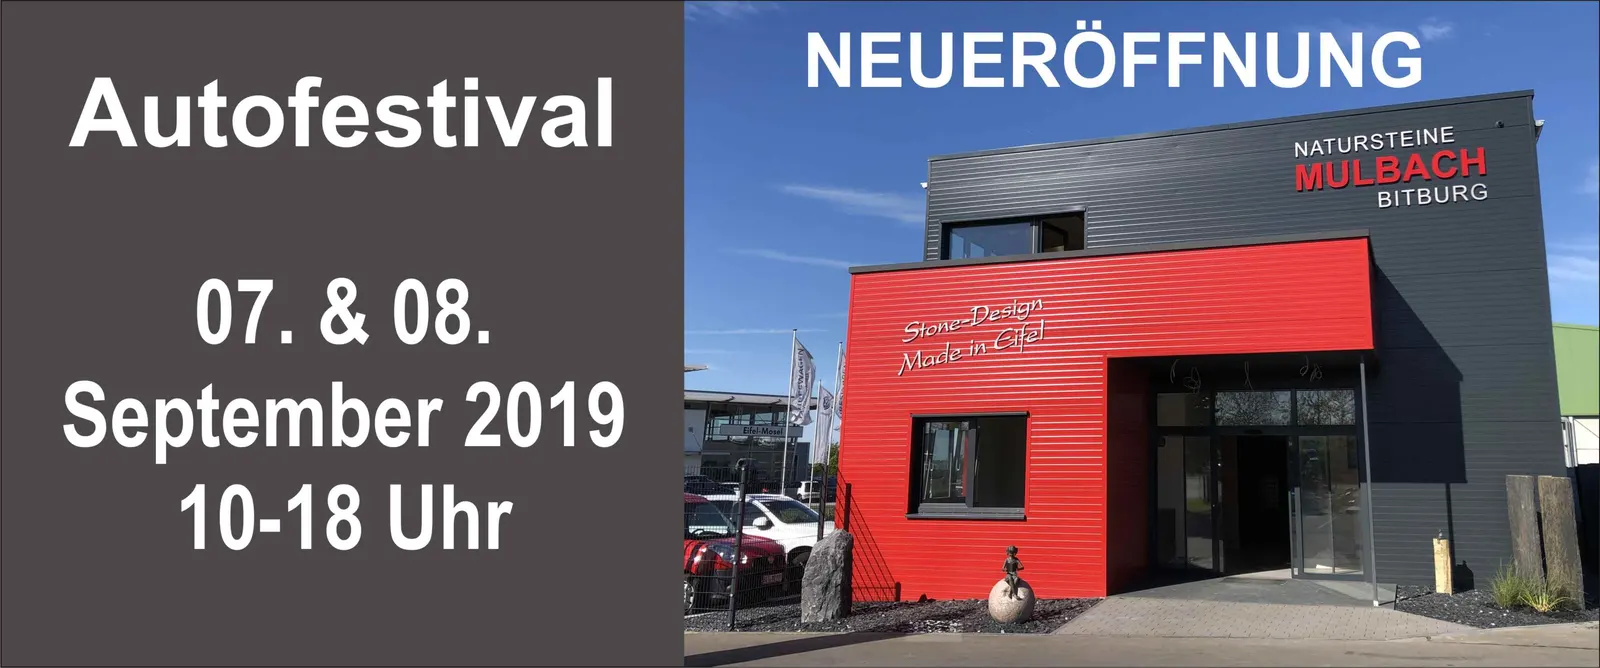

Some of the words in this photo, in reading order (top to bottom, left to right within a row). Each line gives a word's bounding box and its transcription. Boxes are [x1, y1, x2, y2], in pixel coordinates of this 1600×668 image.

[1294, 126, 1455, 158] NATURSTEINE
[1294, 147, 1487, 192] MULBACH
[1377, 184, 1488, 208] BITBURG
[902, 299, 1044, 343] Stone-Design
[898, 342, 962, 376] Made
[969, 340, 987, 356] in
[993, 319, 1045, 352] Eifel
[742, 426, 784, 436] Eifel-Mosel
